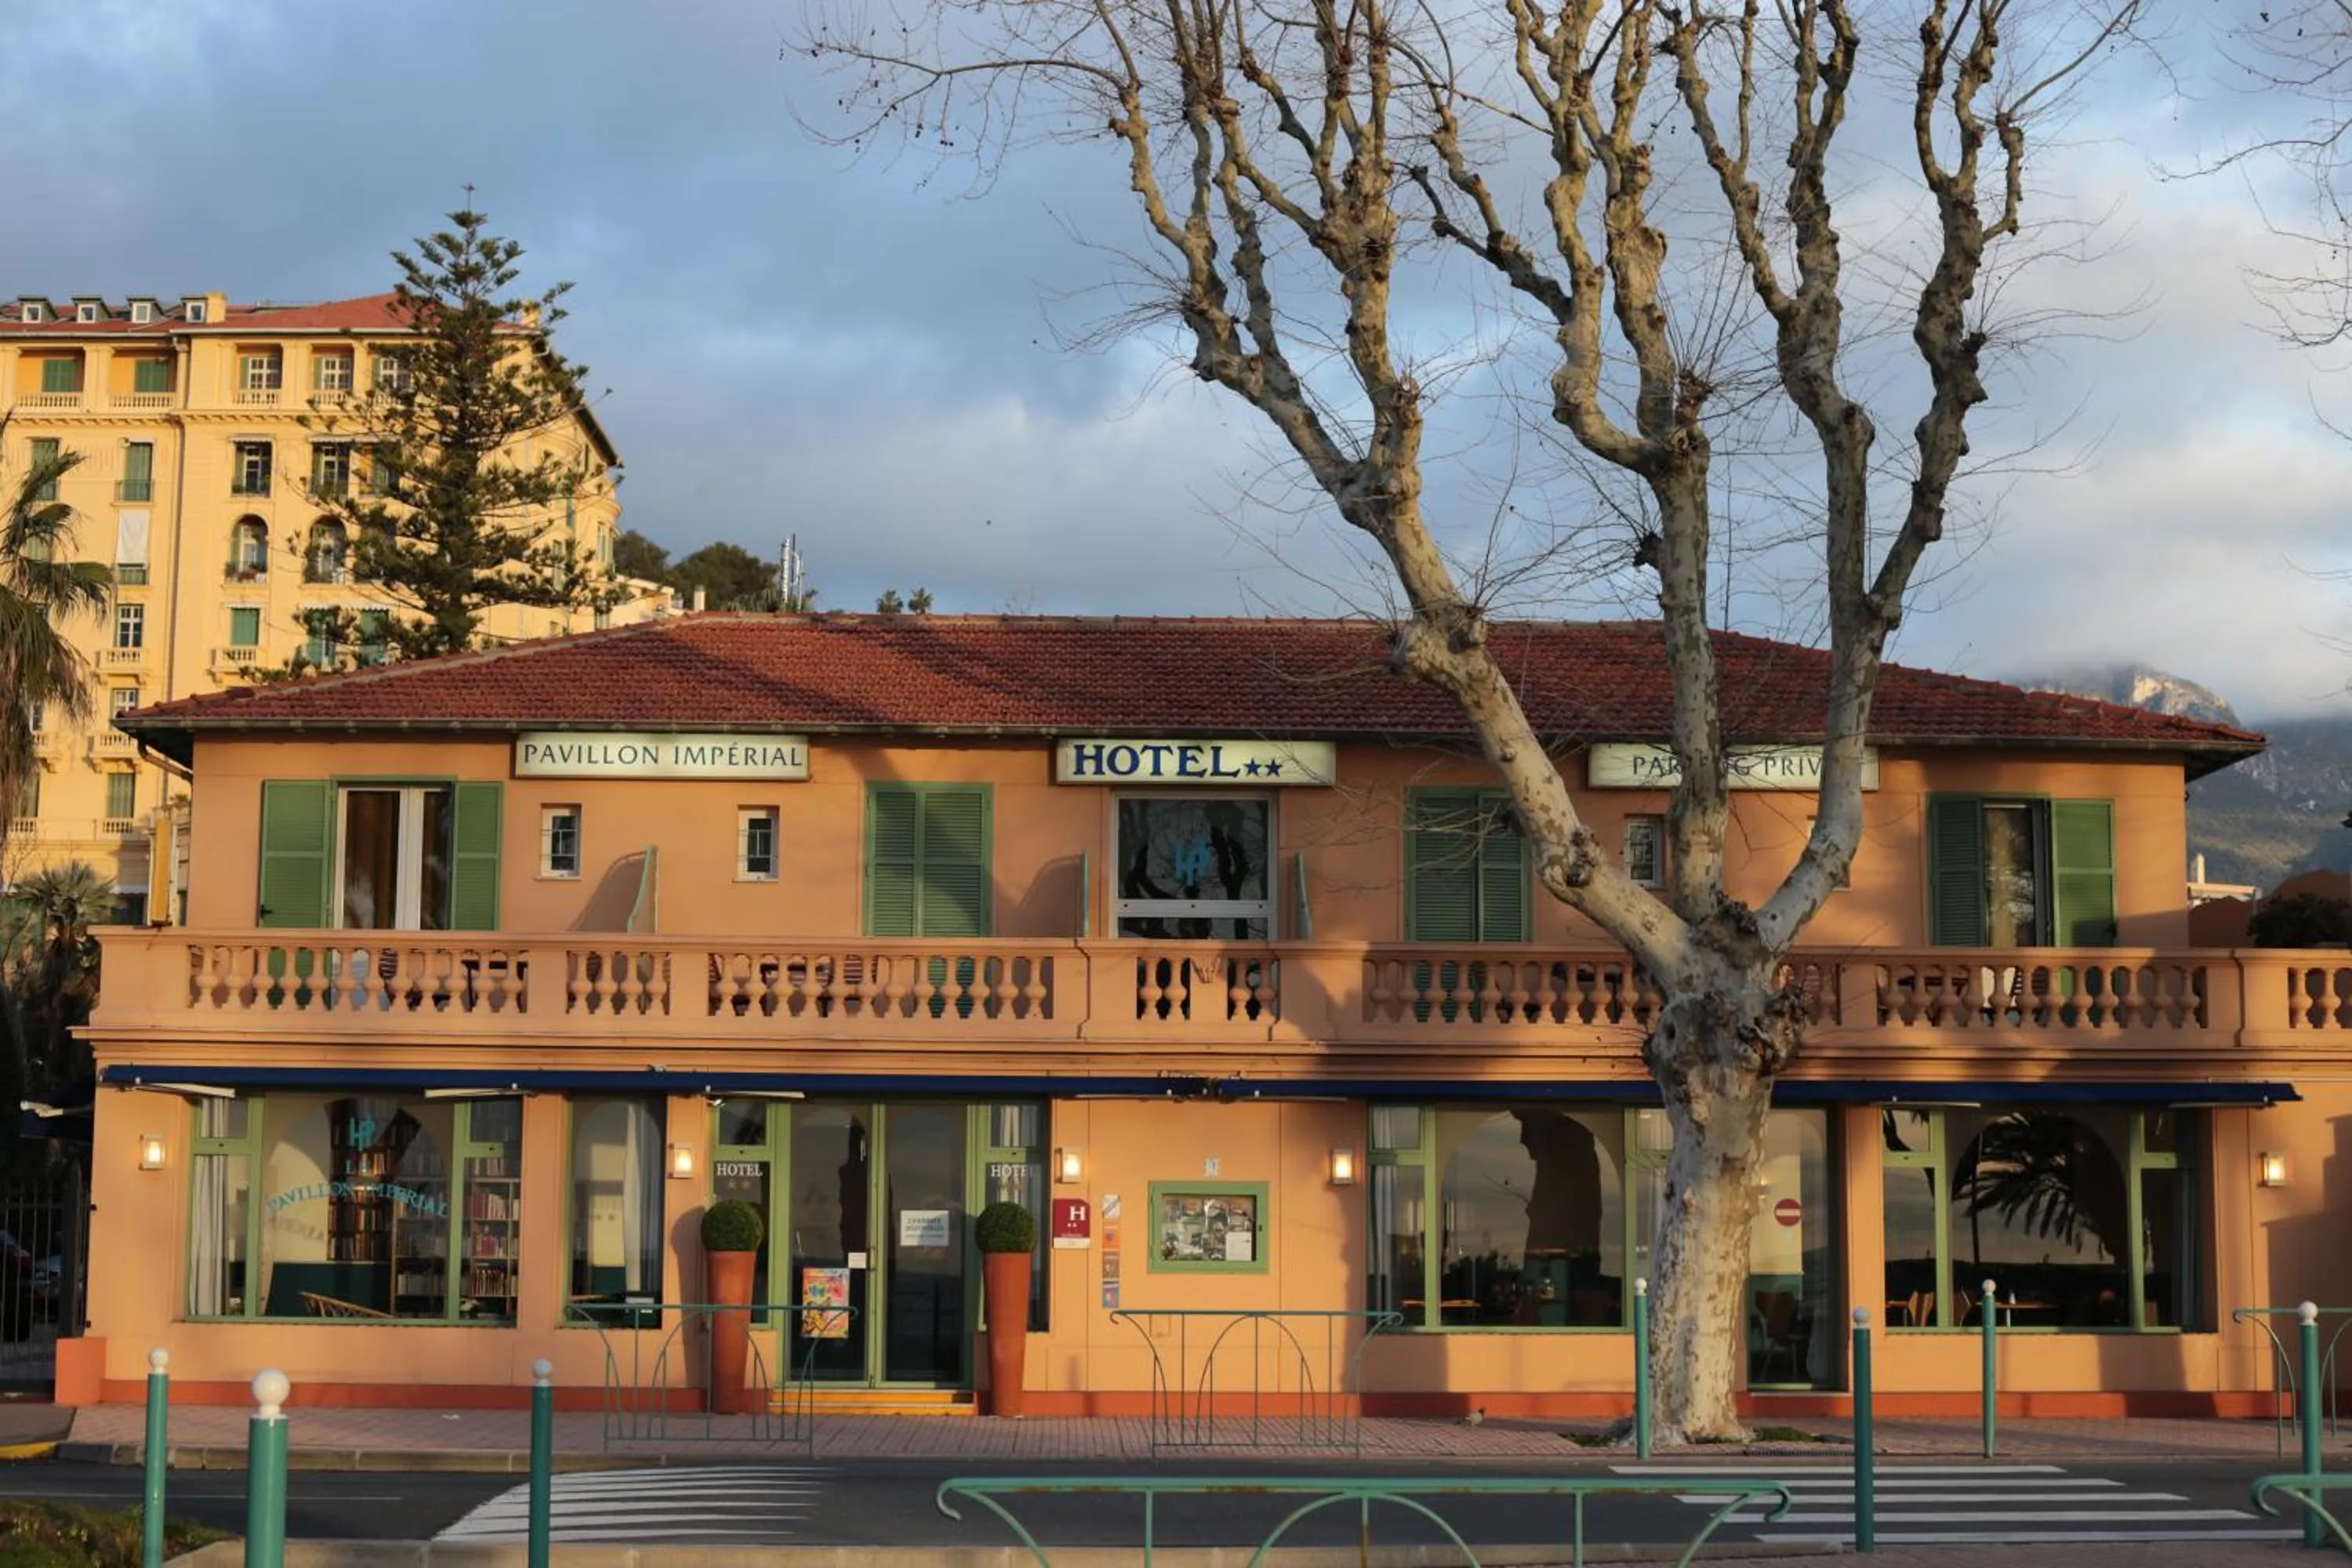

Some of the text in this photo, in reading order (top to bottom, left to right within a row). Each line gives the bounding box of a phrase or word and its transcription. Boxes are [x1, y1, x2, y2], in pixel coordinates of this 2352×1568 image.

[524, 741, 803, 767] PAVILLON IMPÉRIAL
[1073, 743, 1241, 779] HOTEL
[1633, 755, 1824, 777] PARG PRIV
[717, 1163, 764, 1176] HOTEL
[1069, 1206, 1086, 1221] H
